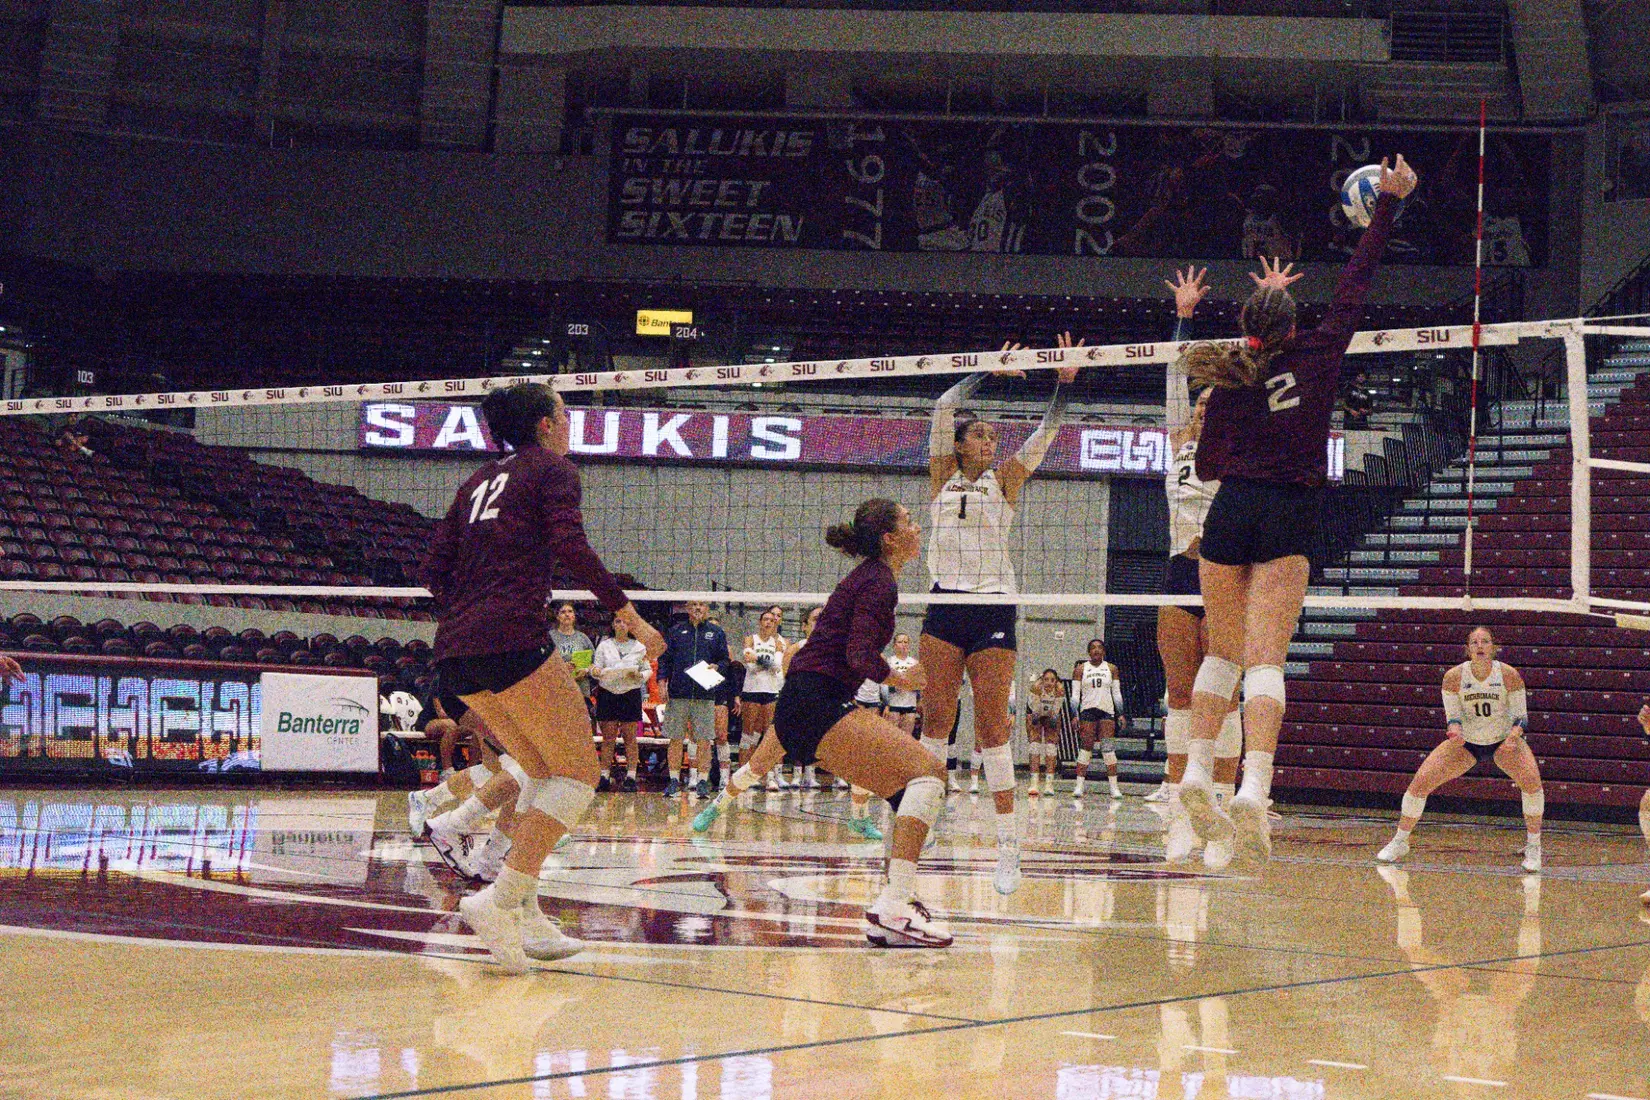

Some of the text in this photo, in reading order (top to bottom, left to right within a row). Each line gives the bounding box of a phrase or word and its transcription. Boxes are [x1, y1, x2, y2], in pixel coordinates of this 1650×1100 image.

[622, 127, 815, 157] SALUKIS
[621, 158, 706, 175] IN THE
[619, 178, 771, 207] SWEET
[844, 125, 886, 250] 1977
[1074, 130, 1117, 255] 2002
[617, 211, 805, 242] SIXTEEN
[567, 323, 590, 336] 203
[675, 326, 698, 339] 204
[7, 401, 23, 411] SIU
[55, 399, 72, 409] SIU
[105, 397, 123, 407] SIU
[157, 394, 175, 404] SIU
[211, 392, 229, 402] SIU
[266, 390, 285, 400] SIU
[323, 387, 343, 397] SIU
[382, 383, 403, 394] SIU
[444, 381, 466, 392] SIU
[575, 374, 598, 385] SIU
[644, 371, 668, 382] SIU
[716, 367, 741, 379] SIU
[792, 363, 817, 375] SIU
[870, 359, 896, 372] SIU
[951, 354, 978, 368] SIU
[1036, 350, 1065, 364] SIU
[1125, 344, 1155, 358] SIU
[1416, 329, 1450, 343] SIU
[77, 370, 94, 384] 103
[1264, 371, 1301, 412] 2
[364, 402, 802, 460] SAUKIS
[1178, 465, 1192, 486] 2
[468, 472, 510, 525] 12
[958, 494, 968, 519] 1
[1091, 678, 1103, 689] 18
[277, 712, 360, 735] Banterra
[1474, 702, 1492, 718] 10
